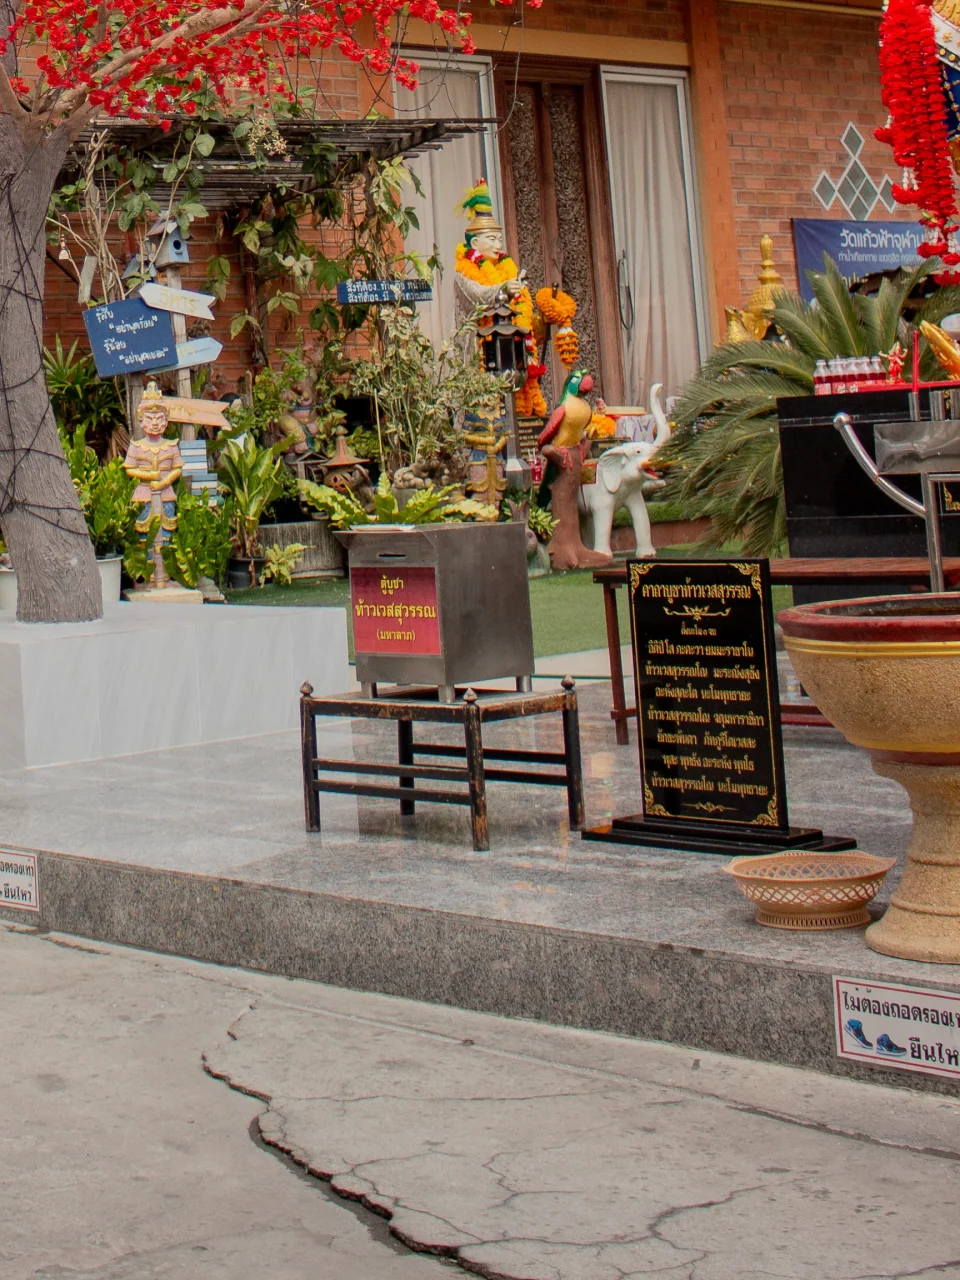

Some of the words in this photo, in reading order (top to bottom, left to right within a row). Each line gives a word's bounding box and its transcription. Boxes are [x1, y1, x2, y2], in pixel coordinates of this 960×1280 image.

[380, 575, 404, 595] ตู้บูชา
[642, 577, 751, 604] คาถาบูชาท้าวเวสสุวรรณ
[355, 598, 437, 626] ท้าวเวสสุวรรณ
[376, 628, 416, 642] (มหาลาภ)
[3, 882, 33, 902] ยืนไหว้
[907, 1036, 960, 1067] ยืนไห
